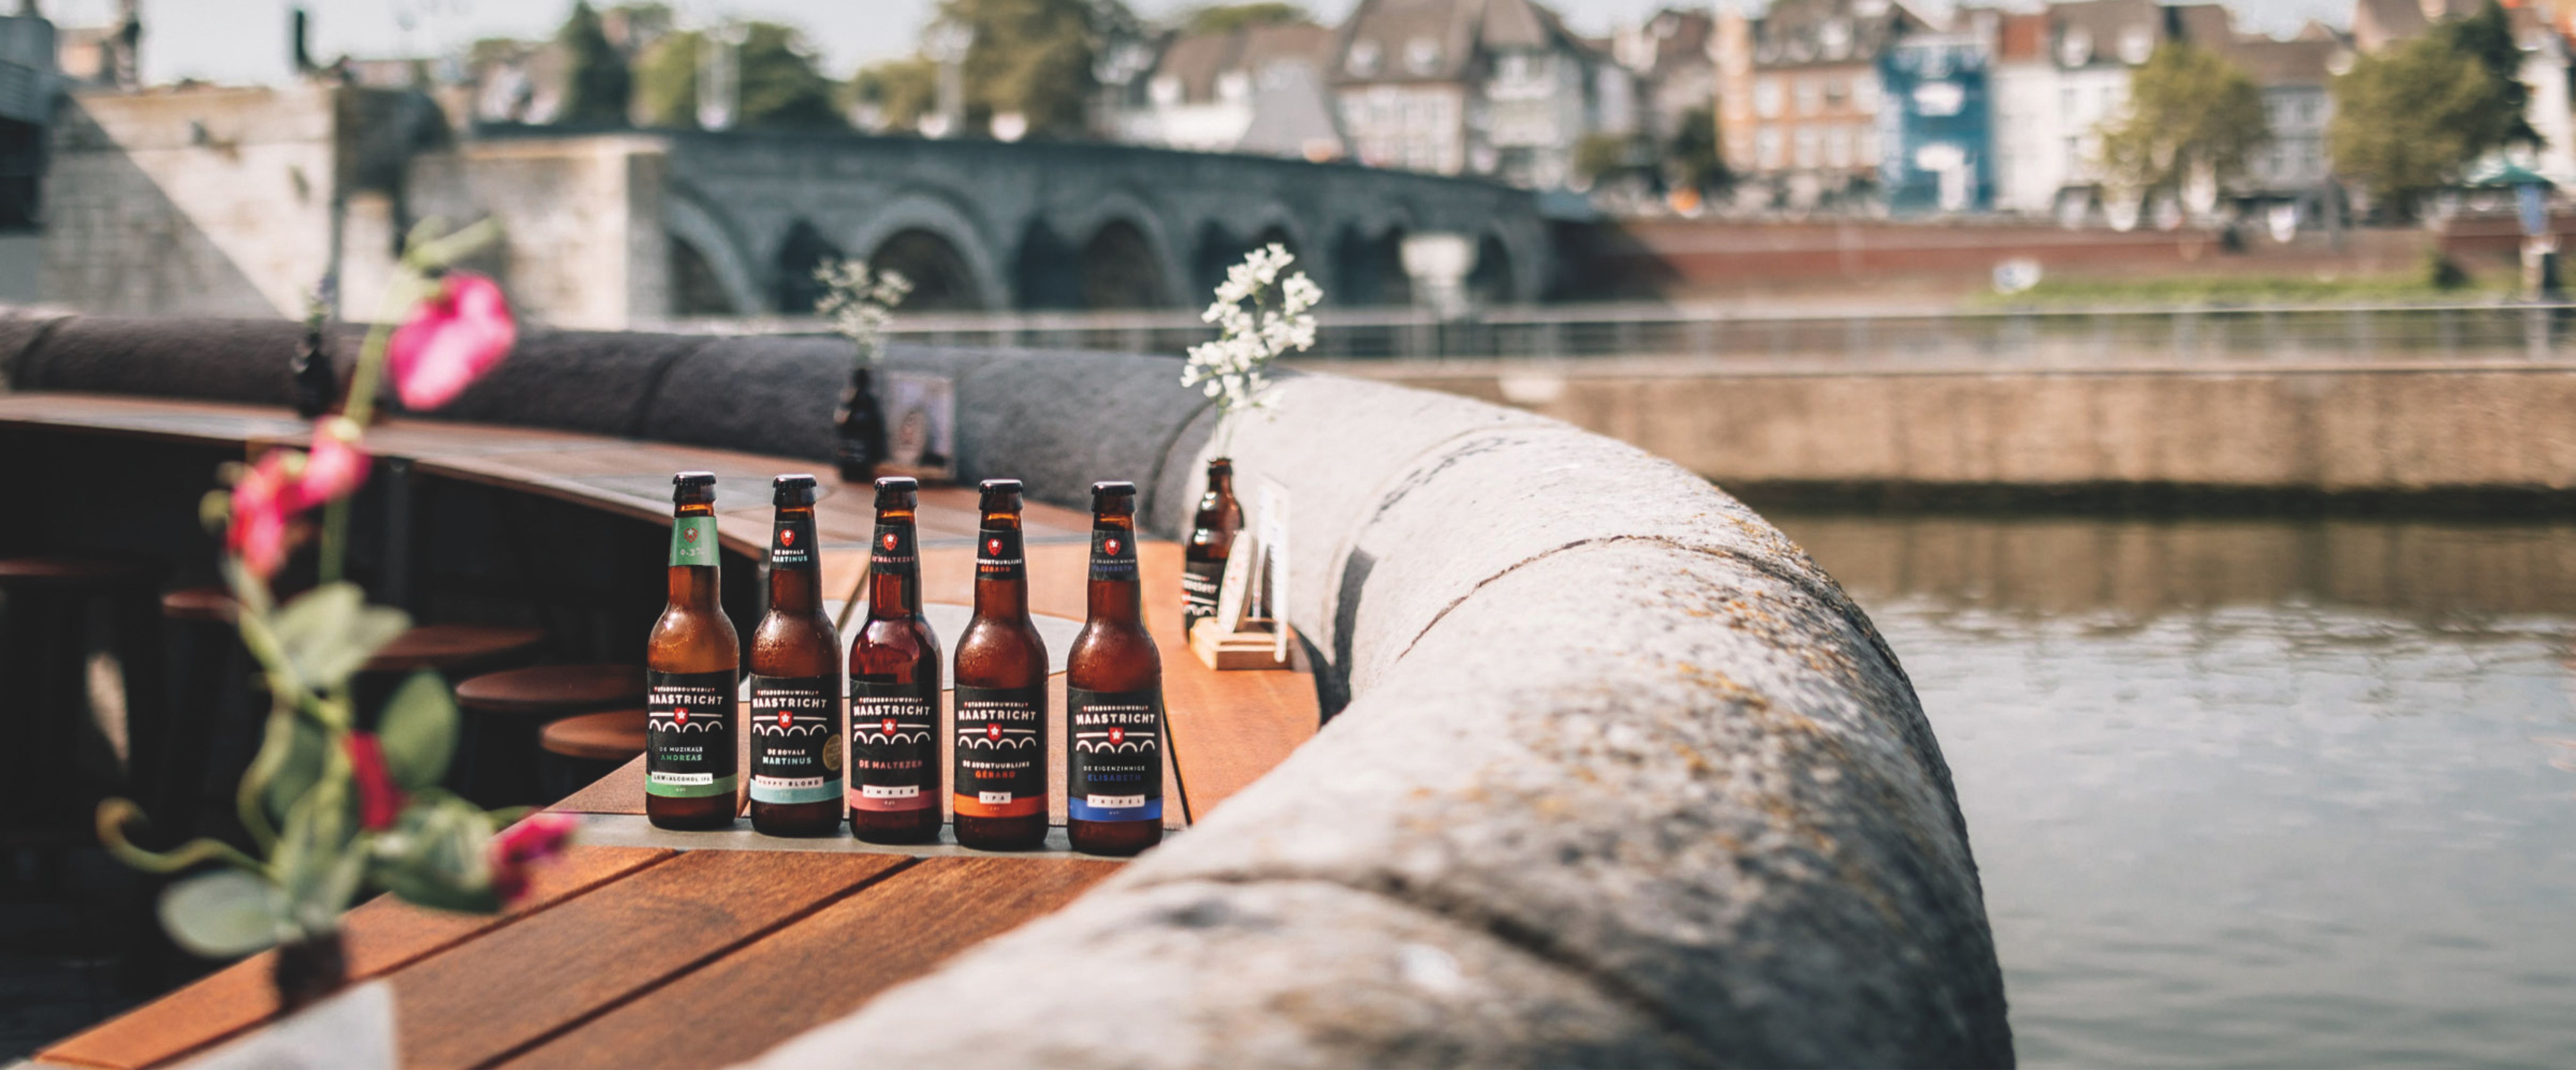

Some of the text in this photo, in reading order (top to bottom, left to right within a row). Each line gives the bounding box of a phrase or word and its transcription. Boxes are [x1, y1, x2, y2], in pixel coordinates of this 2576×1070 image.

[649, 694, 723, 705] MAASTRICHT
[752, 697, 827, 708] MAASTRICHT
[853, 705, 931, 716] MAASTRICHT
[958, 709, 1036, 721] MAASTRICHT
[1076, 713, 1155, 725] MAASTRICHT
[763, 756, 812, 765] MARTINUS
[859, 759, 922, 769] DE MALTEZER
